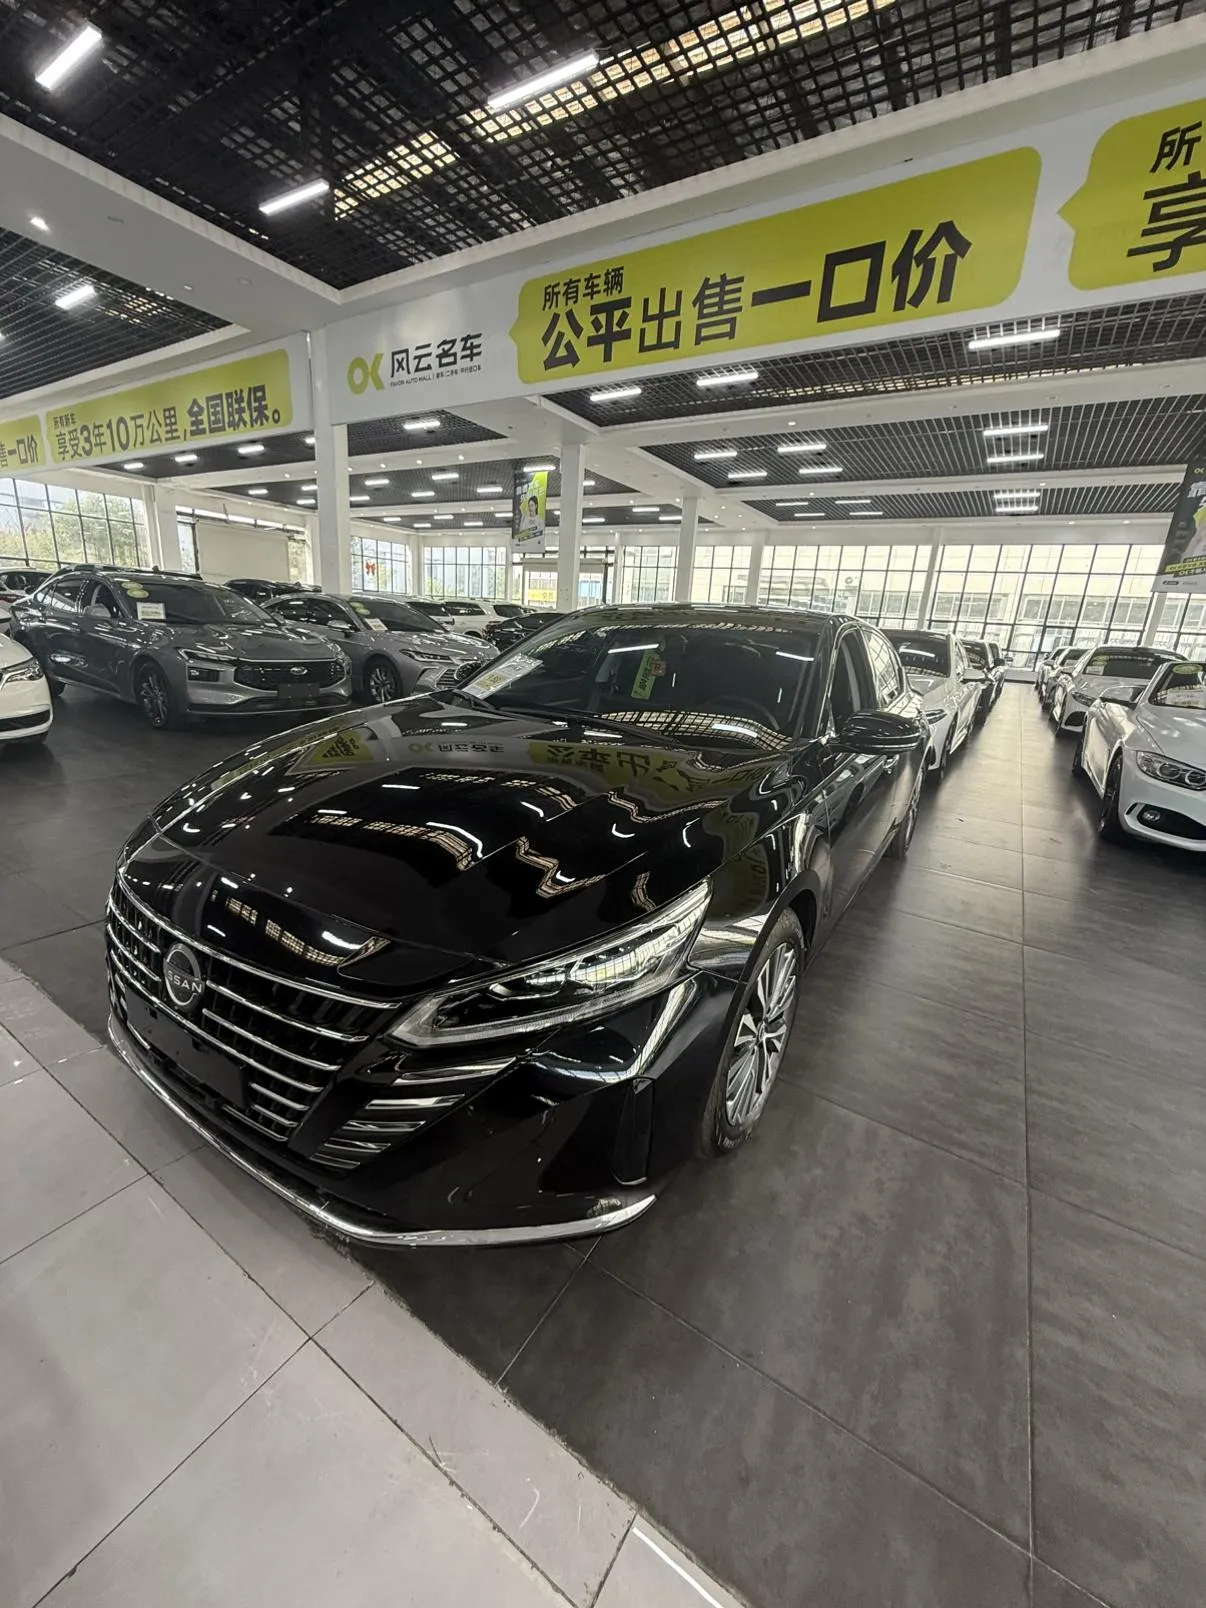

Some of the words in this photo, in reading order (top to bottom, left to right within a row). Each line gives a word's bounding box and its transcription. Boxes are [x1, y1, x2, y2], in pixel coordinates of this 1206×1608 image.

[1150, 121, 1203, 173] 所
[542, 266, 625, 312] 所有车辆
[542, 220, 972, 371] 公平出售一口价
[391, 333, 482, 378] 风云名车
